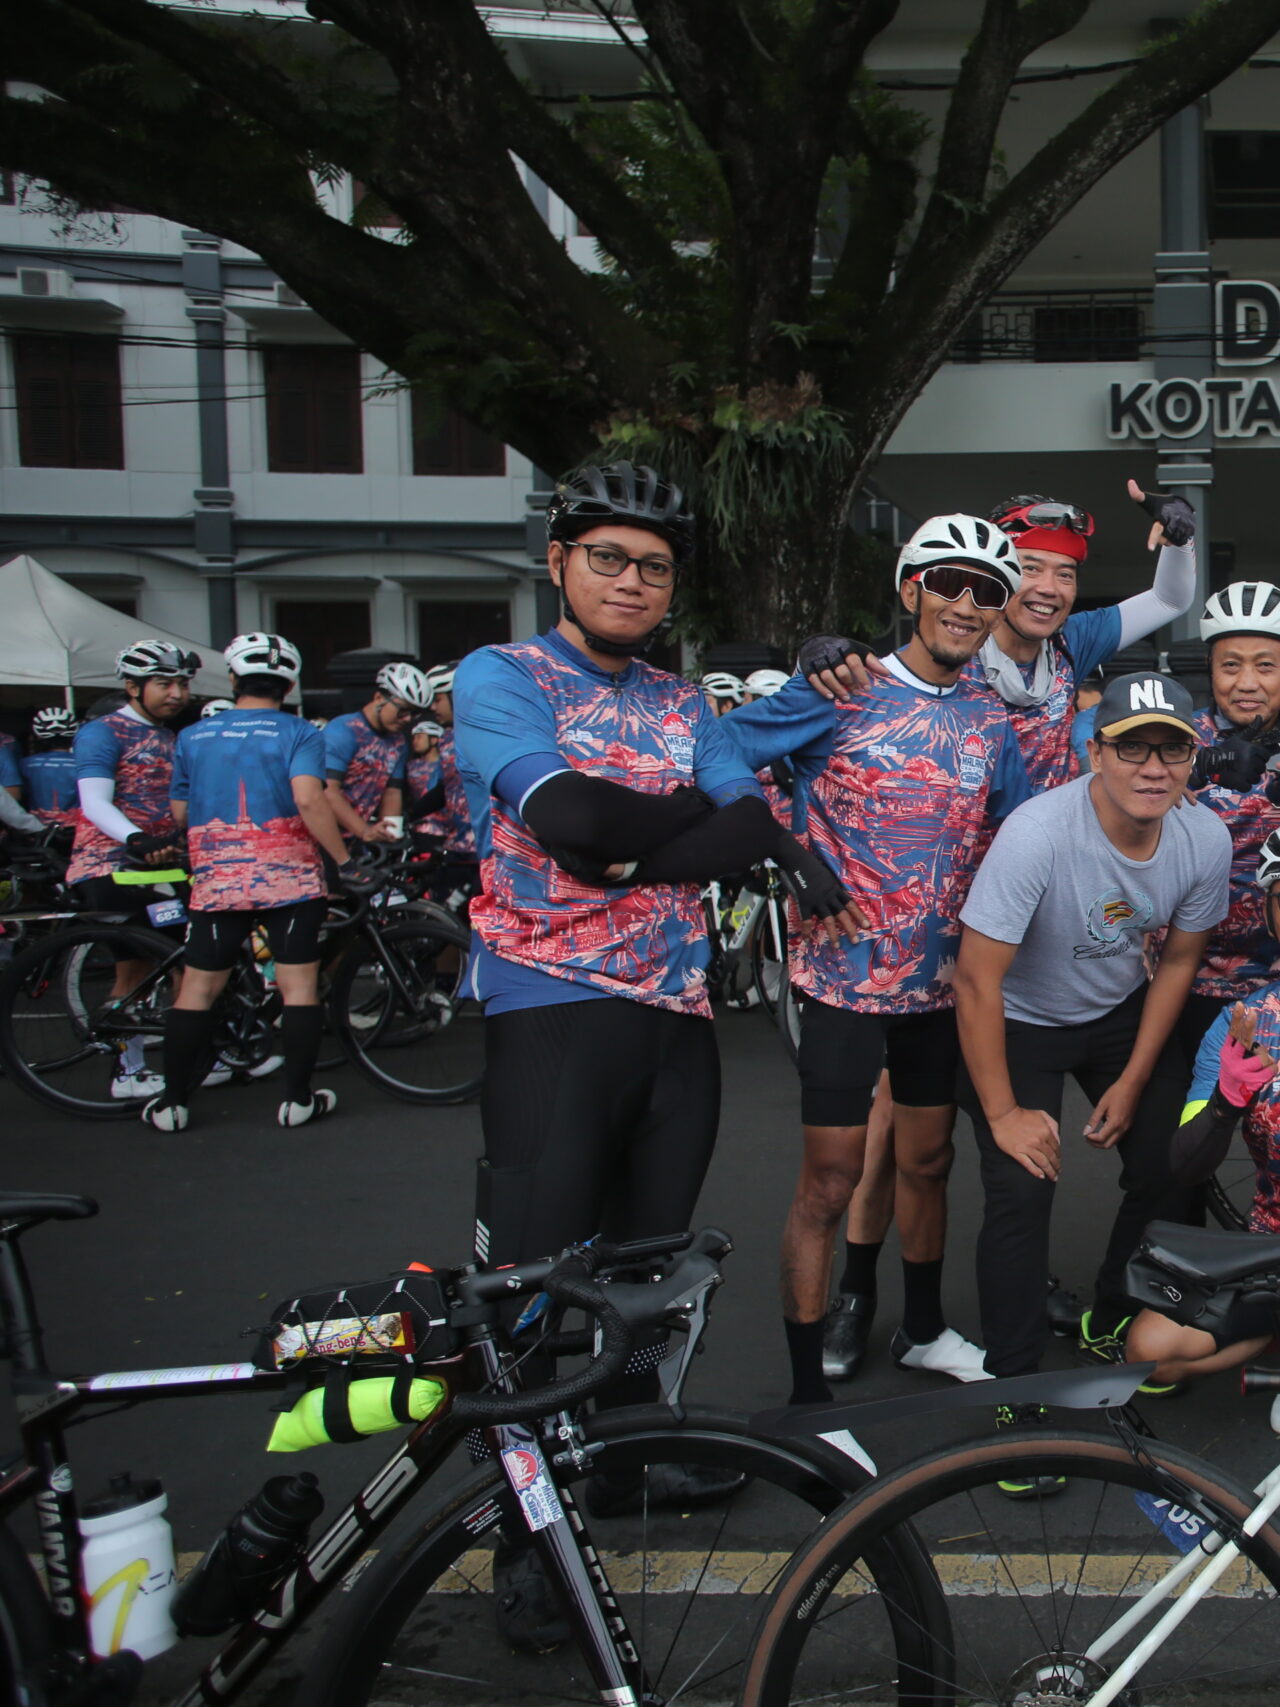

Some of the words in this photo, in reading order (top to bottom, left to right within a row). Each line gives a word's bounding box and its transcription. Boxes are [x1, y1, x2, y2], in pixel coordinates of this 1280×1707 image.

[1129, 678, 1175, 712] NL
[155, 908, 182, 923] 682
[542, 1484, 564, 1520] MALANG
[39, 1488, 78, 1618] VANYAR
